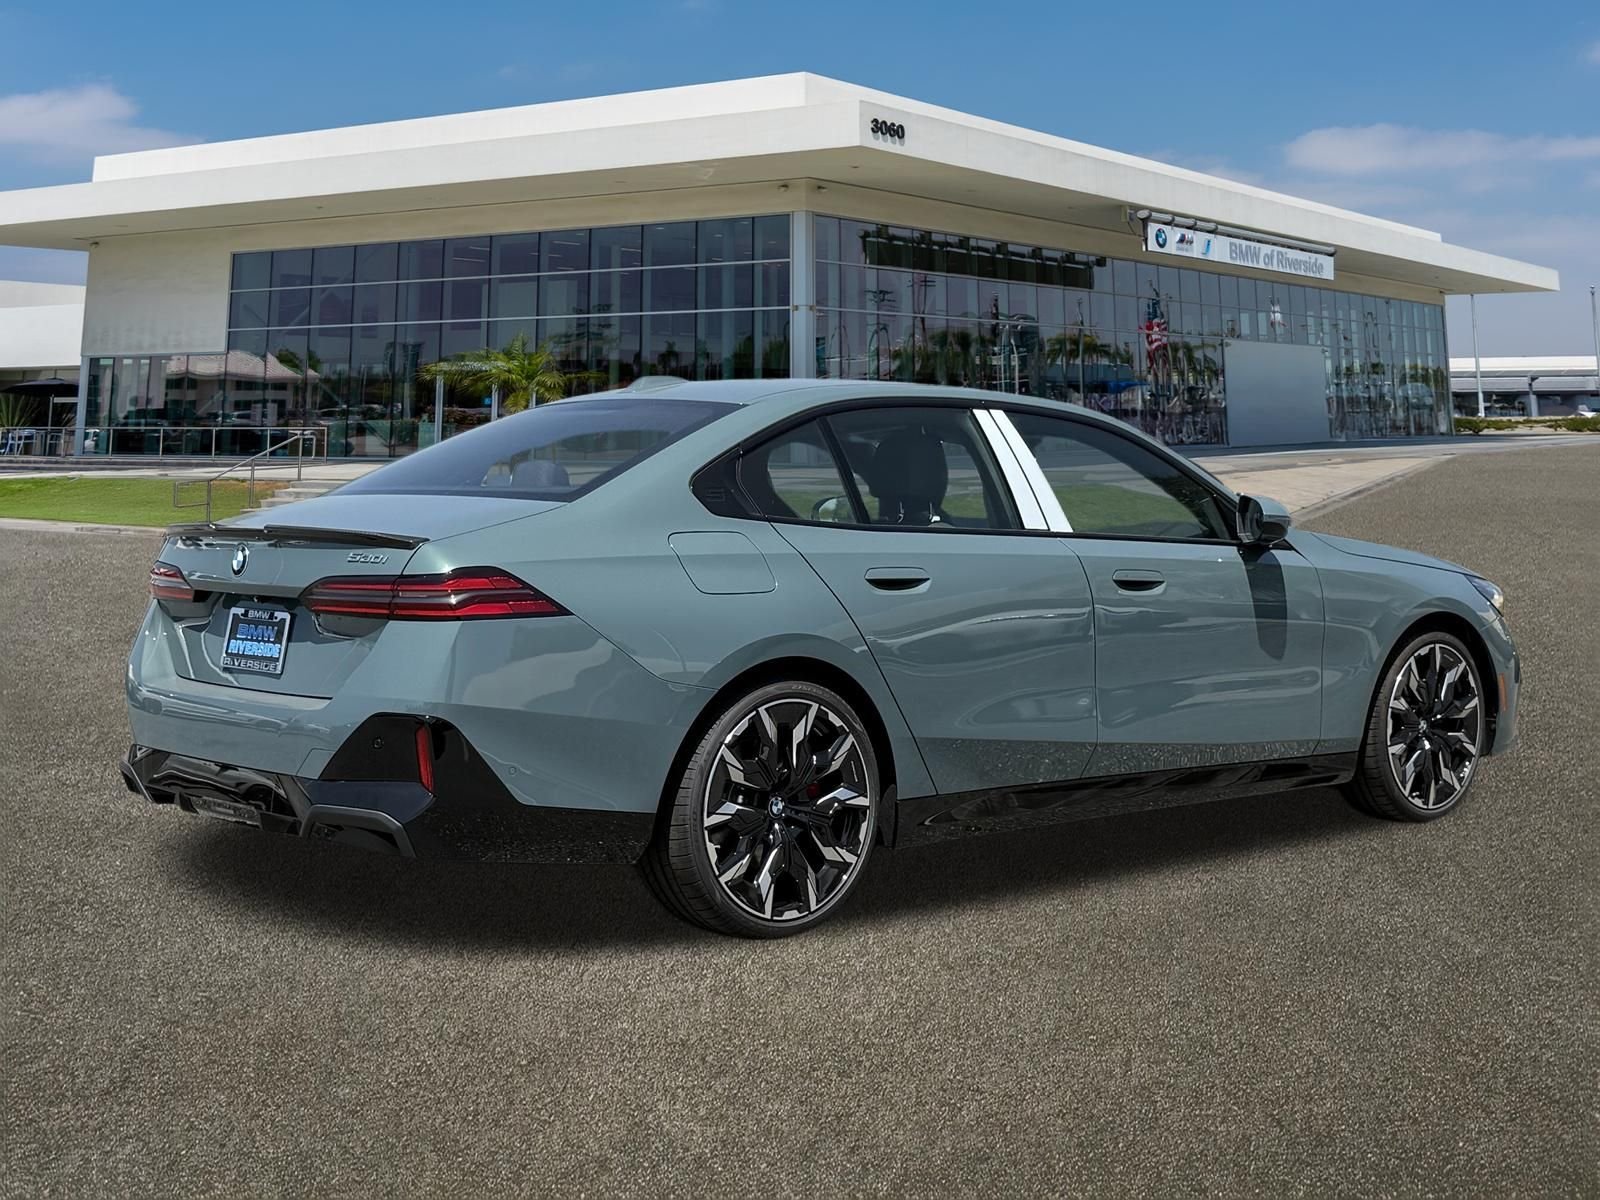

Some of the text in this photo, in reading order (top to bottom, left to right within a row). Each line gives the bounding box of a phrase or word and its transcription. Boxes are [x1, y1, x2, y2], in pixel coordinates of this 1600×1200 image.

[870, 118, 905, 139] 3060
[1229, 241, 1261, 264] BMW
[1263, 249, 1275, 266] of
[1276, 250, 1324, 275] Riverside
[248, 609, 270, 619] BMW
[236, 623, 278, 641] BMW
[228, 639, 281, 658] RIVERSIDE
[223, 657, 276, 671] RIVERSIDE
